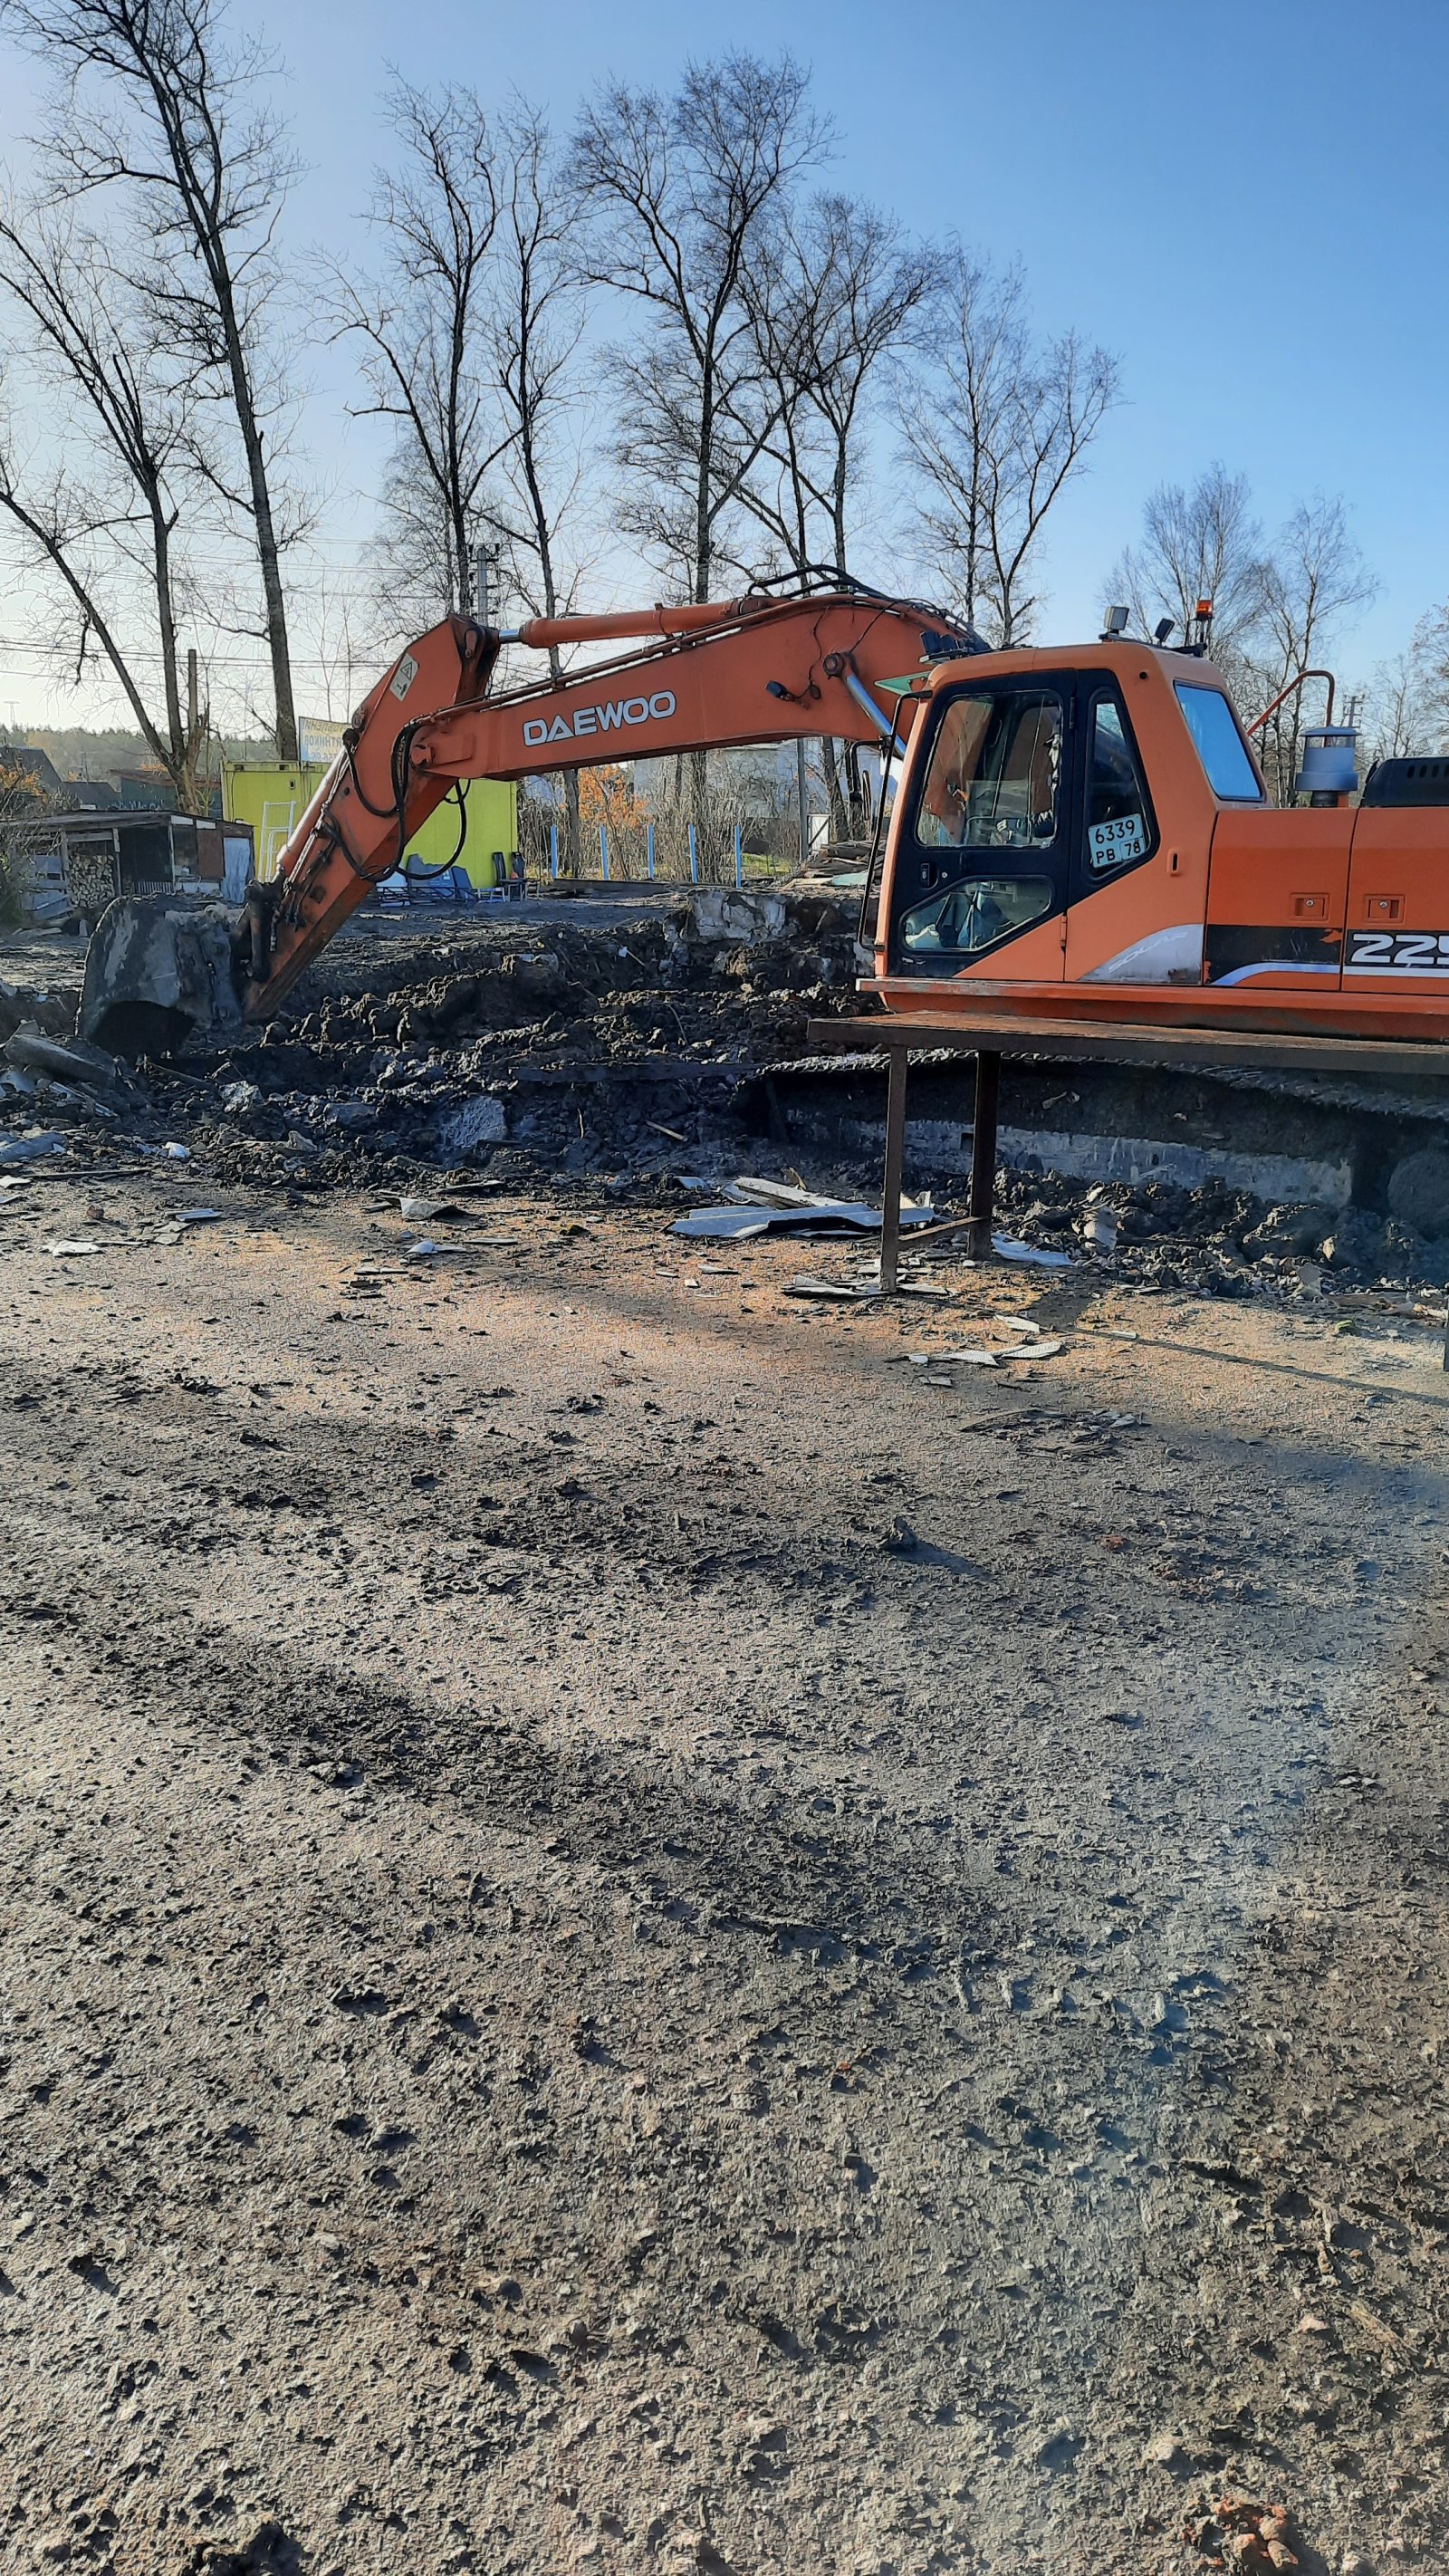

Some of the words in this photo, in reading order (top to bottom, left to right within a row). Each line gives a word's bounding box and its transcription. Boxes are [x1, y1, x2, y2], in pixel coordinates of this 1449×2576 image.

[523, 690, 677, 746] DAEWOO
[1095, 820, 1135, 844] 6339
[1096, 849, 1115, 864] РВ
[1124, 841, 1141, 857] 78
